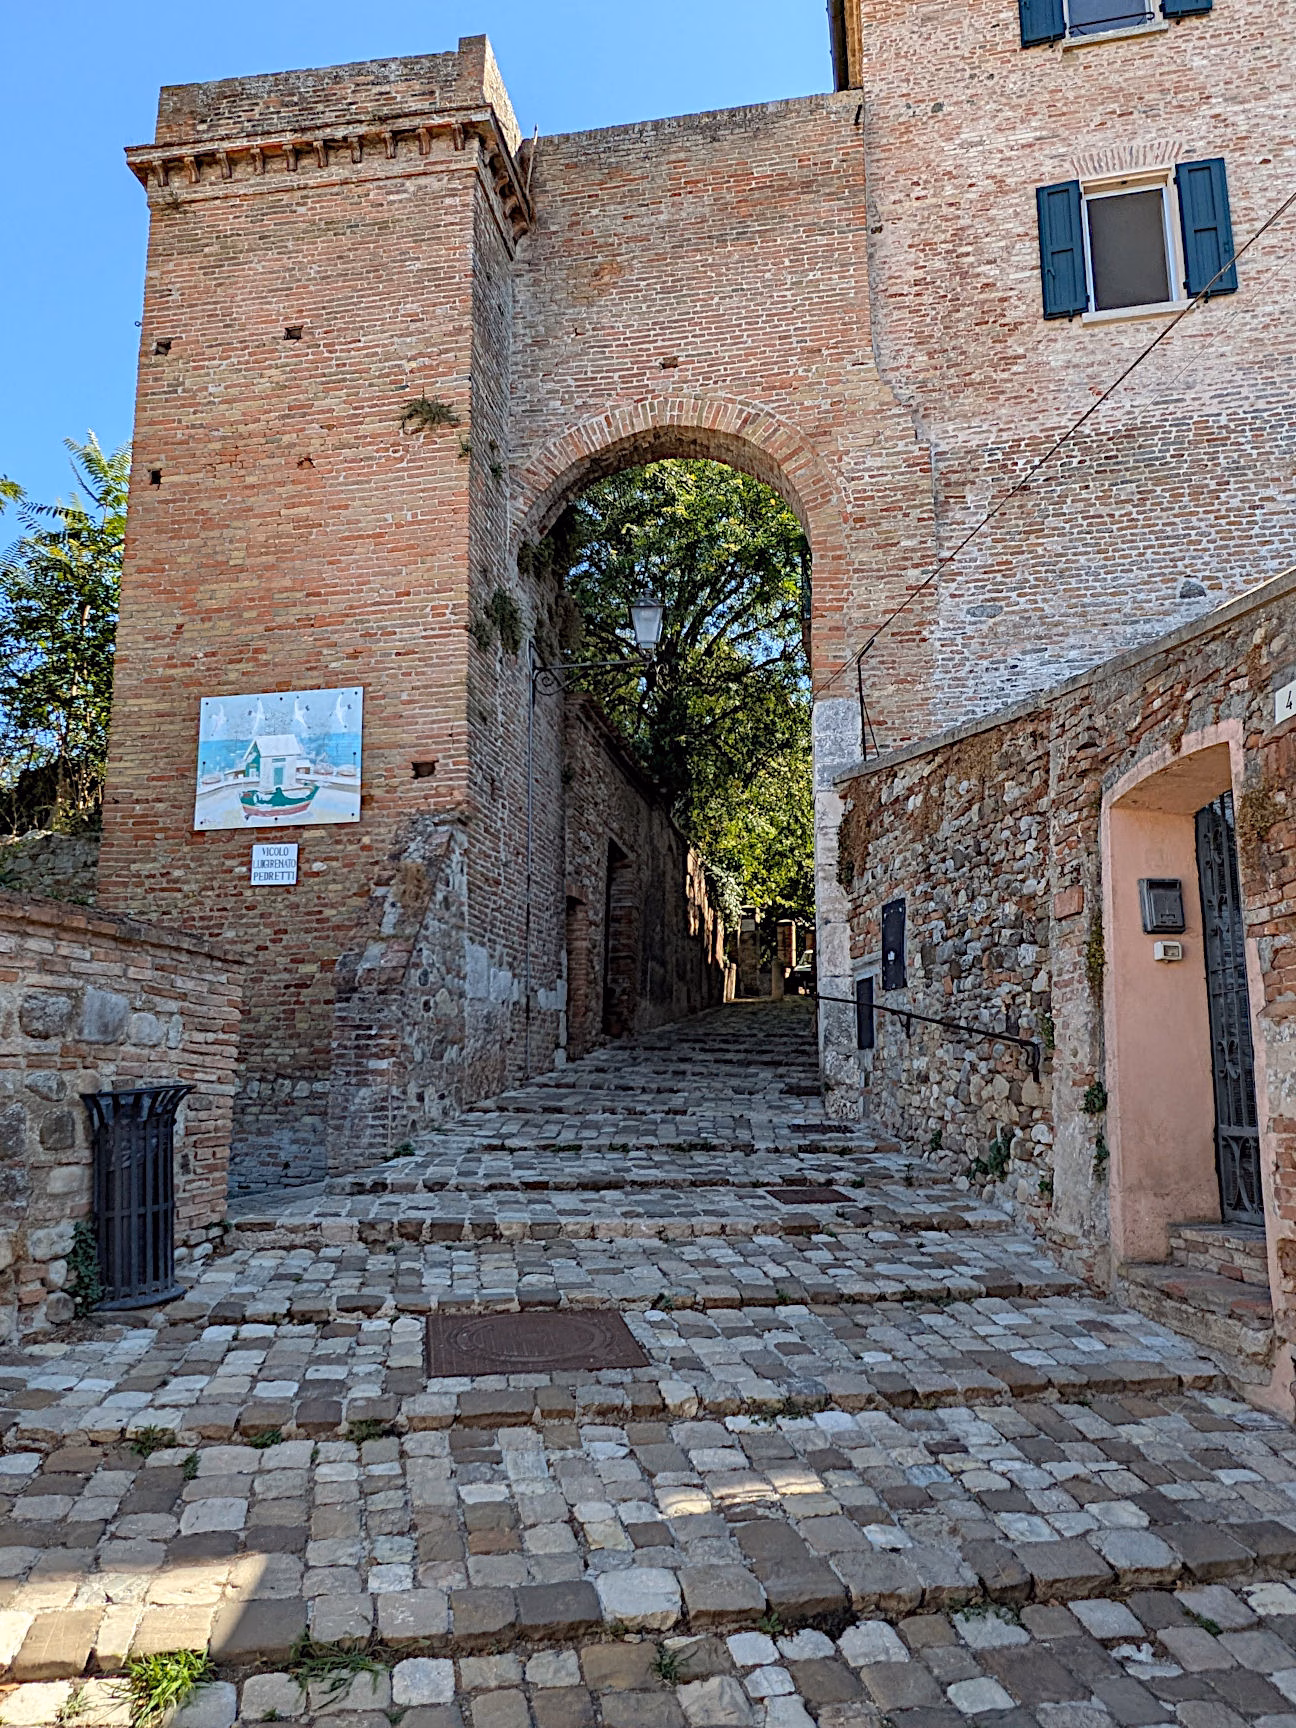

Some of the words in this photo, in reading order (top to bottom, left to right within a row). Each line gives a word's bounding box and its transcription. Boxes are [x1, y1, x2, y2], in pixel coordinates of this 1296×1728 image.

[1286, 690, 1293, 710] 4
[262, 847, 289, 857] VICOLO
[253, 871, 295, 881] PEDRETTI
